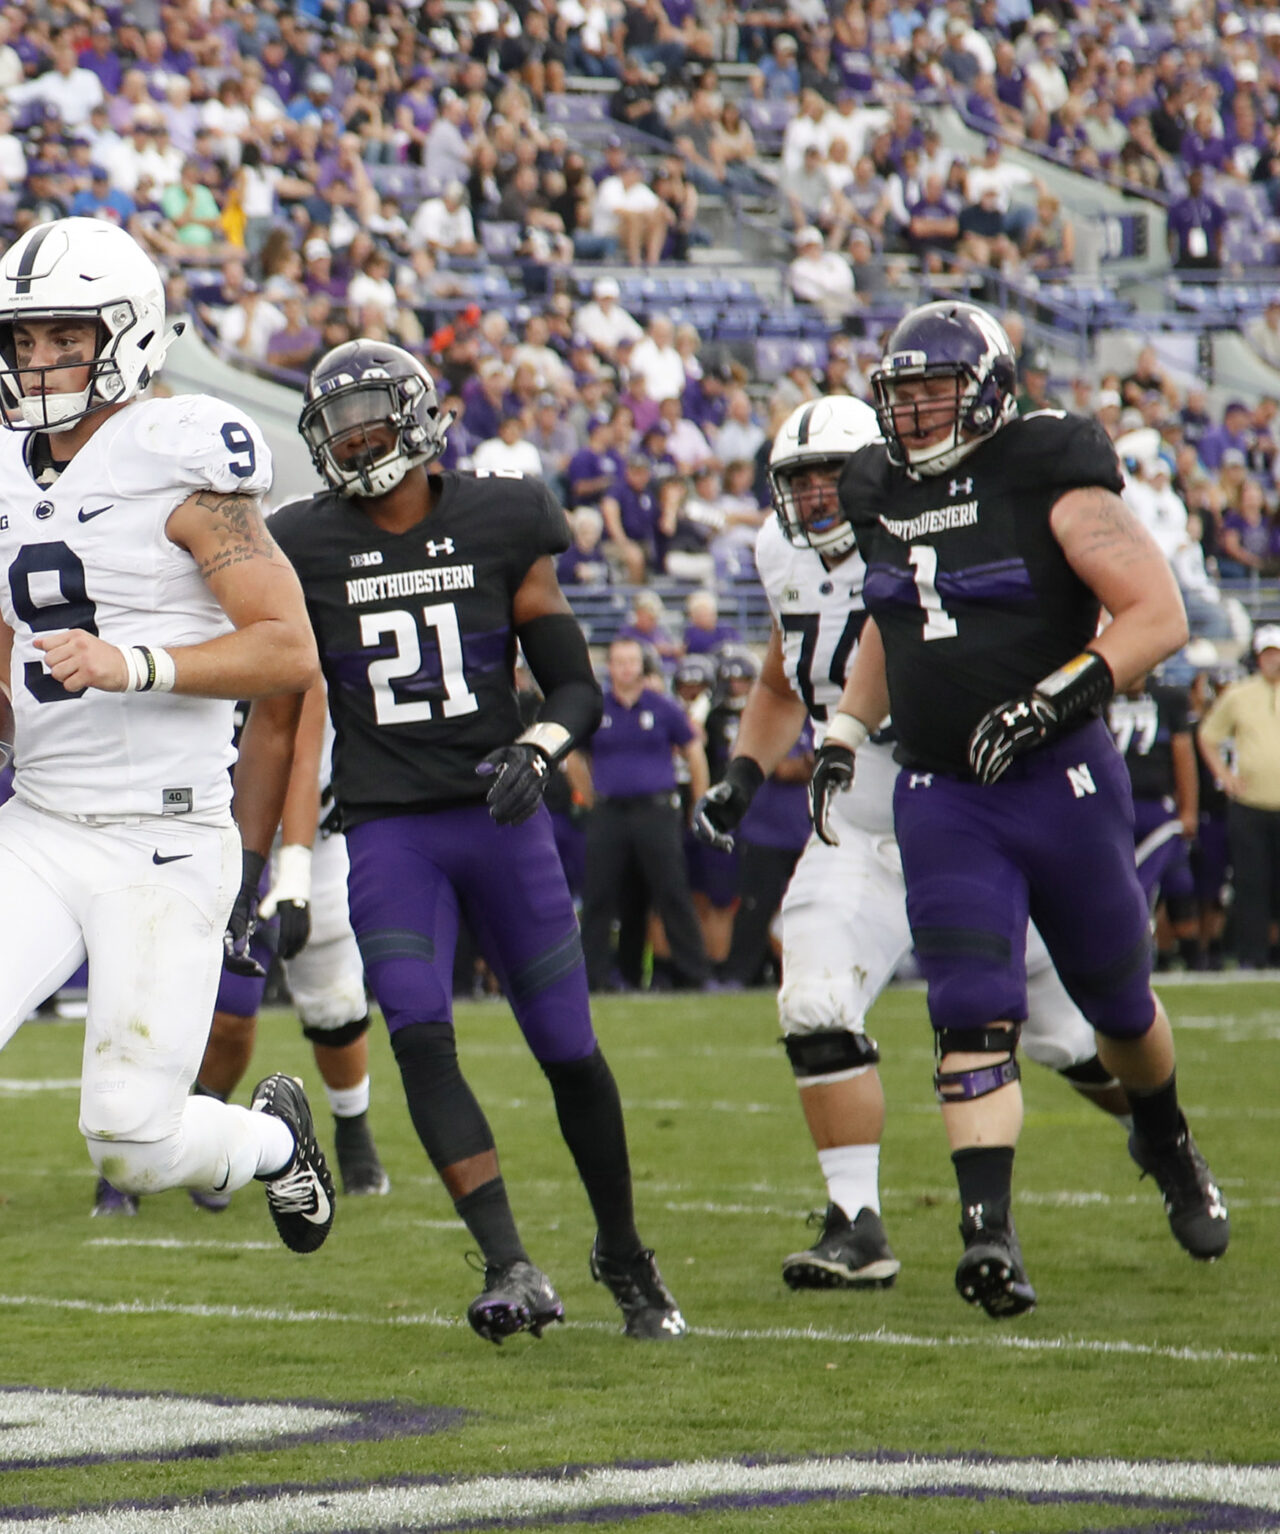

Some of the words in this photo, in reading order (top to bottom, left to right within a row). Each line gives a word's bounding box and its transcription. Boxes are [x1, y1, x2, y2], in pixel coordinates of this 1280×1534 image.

[220, 422, 256, 478] 9
[345, 564, 476, 605] NORTHWESTERN
[908, 545, 959, 642] 1
[8, 540, 100, 704] 9
[359, 602, 479, 726] 21
[1110, 700, 1158, 756] 77
[168, 792, 182, 803] 40
[1066, 763, 1097, 798] N
